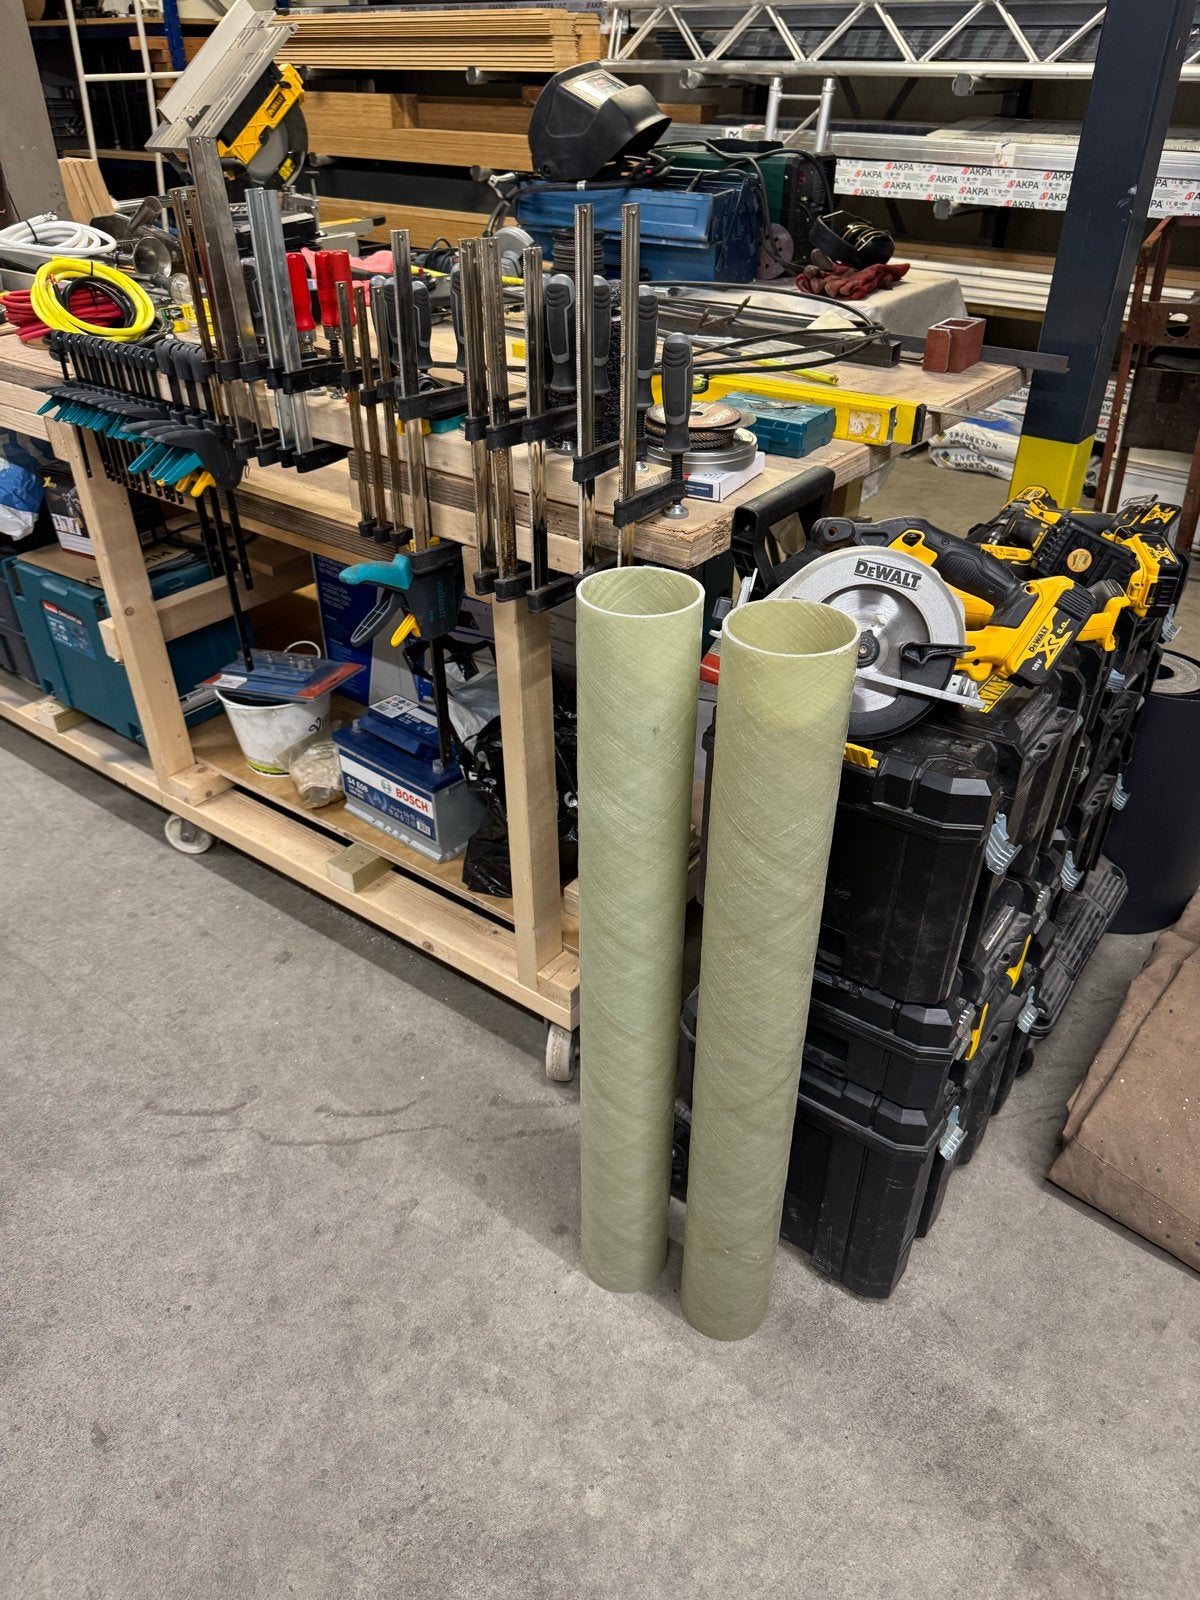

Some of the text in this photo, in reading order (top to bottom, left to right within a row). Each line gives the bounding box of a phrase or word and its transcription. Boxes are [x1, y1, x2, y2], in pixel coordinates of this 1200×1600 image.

[892, 162, 914, 171] AKPA
[862, 170, 882, 178] AKPA
[969, 167, 993, 177] AKPA
[1051, 172, 1072, 181] AKP
[936, 175, 958, 184] AKPA
[890, 182, 911, 190] AKPA
[1015, 180, 1039, 189] AKPA
[860, 189, 880, 197] AKPA
[966, 187, 989, 196] AKPA
[1048, 192, 1068, 201] AKP
[1012, 200, 1036, 208] AKPA
[854, 560, 922, 588] DEWALT
[1028, 626, 1049, 653] DEWALT
[1031, 658, 1043, 671] 18V
[395, 788, 429, 813] BOSCH
